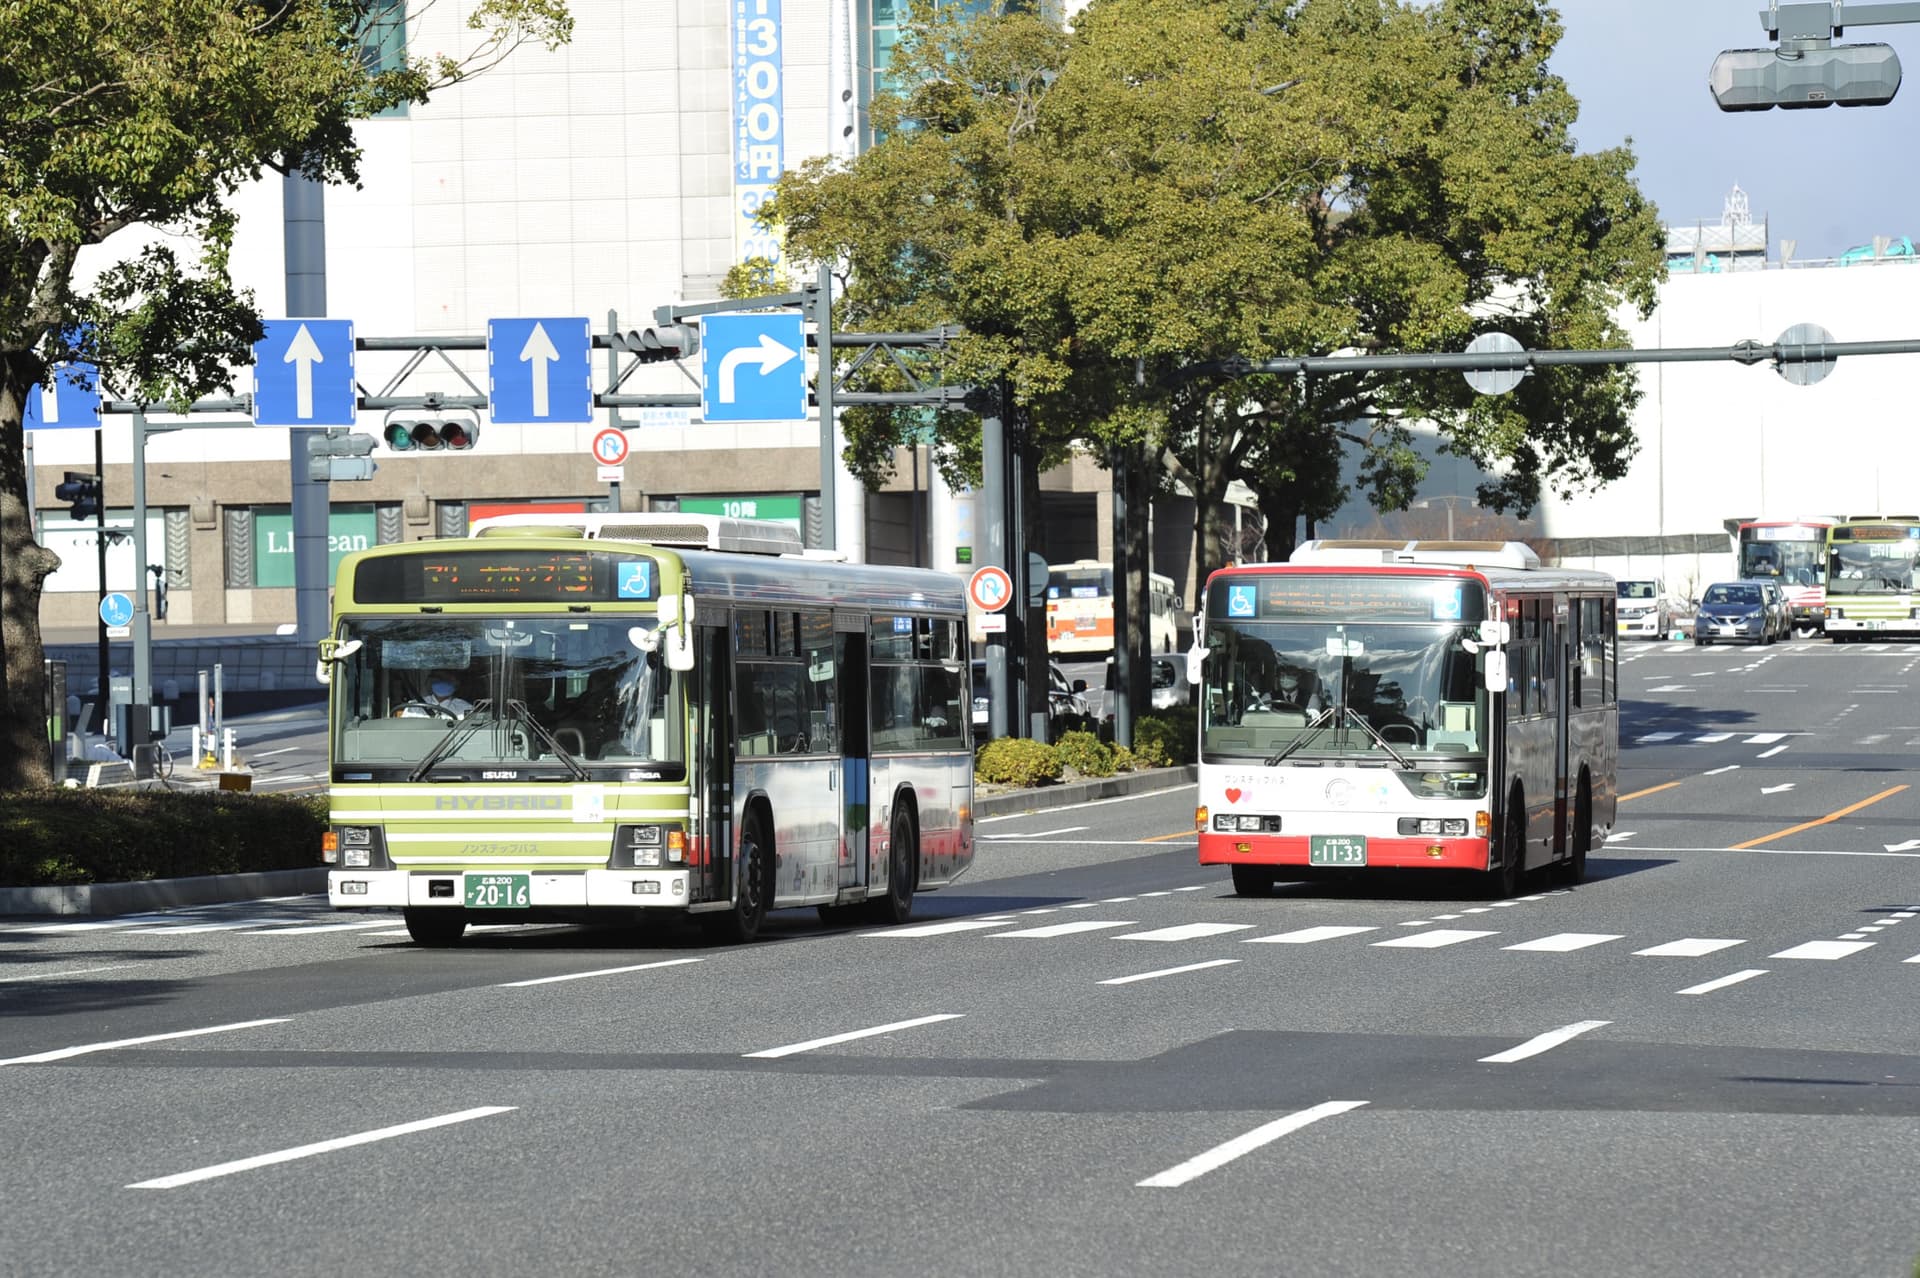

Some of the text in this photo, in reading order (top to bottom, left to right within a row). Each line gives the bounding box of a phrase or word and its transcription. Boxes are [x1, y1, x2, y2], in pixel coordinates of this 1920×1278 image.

[482, 771, 518, 779] ISUZU
[435, 795, 563, 810] HYBRID
[460, 843, 540, 854] ノンステップバス
[475, 885, 527, 906] 20-16
